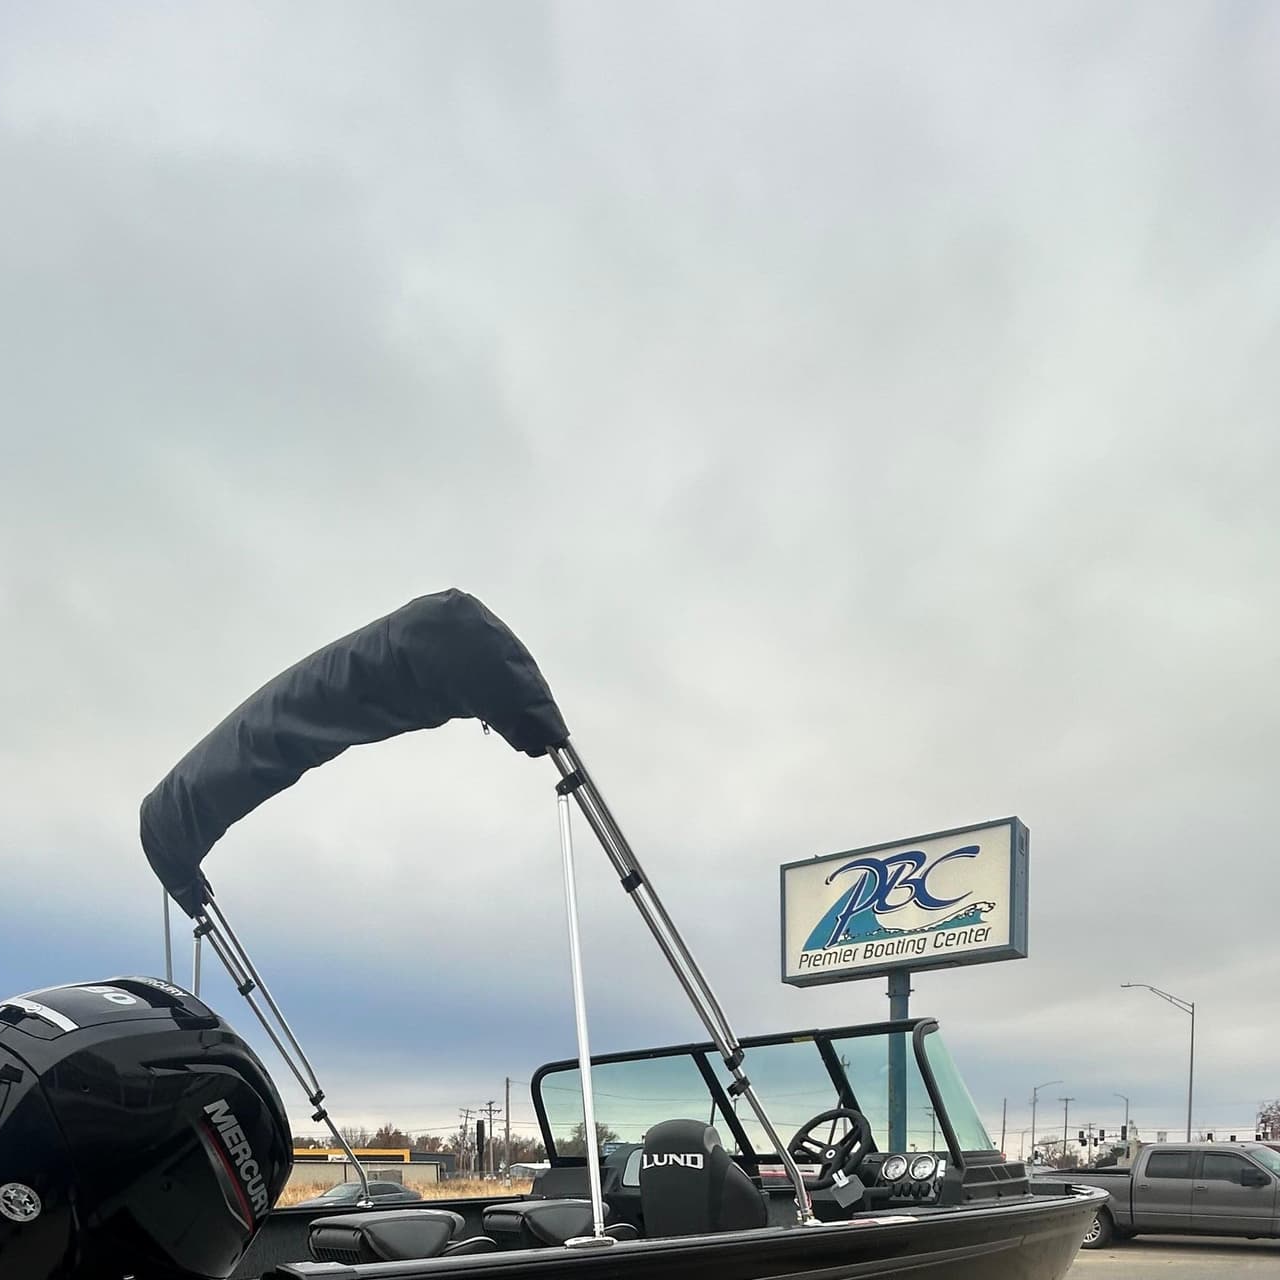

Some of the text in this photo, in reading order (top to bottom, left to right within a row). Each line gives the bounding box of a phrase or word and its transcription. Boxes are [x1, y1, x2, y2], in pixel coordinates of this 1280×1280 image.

[824, 845, 980, 950] PBC
[798, 926, 992, 969] Premier Boating Center
[203, 1098, 270, 1220] MERCURY
[642, 1153, 704, 1170] LUND
